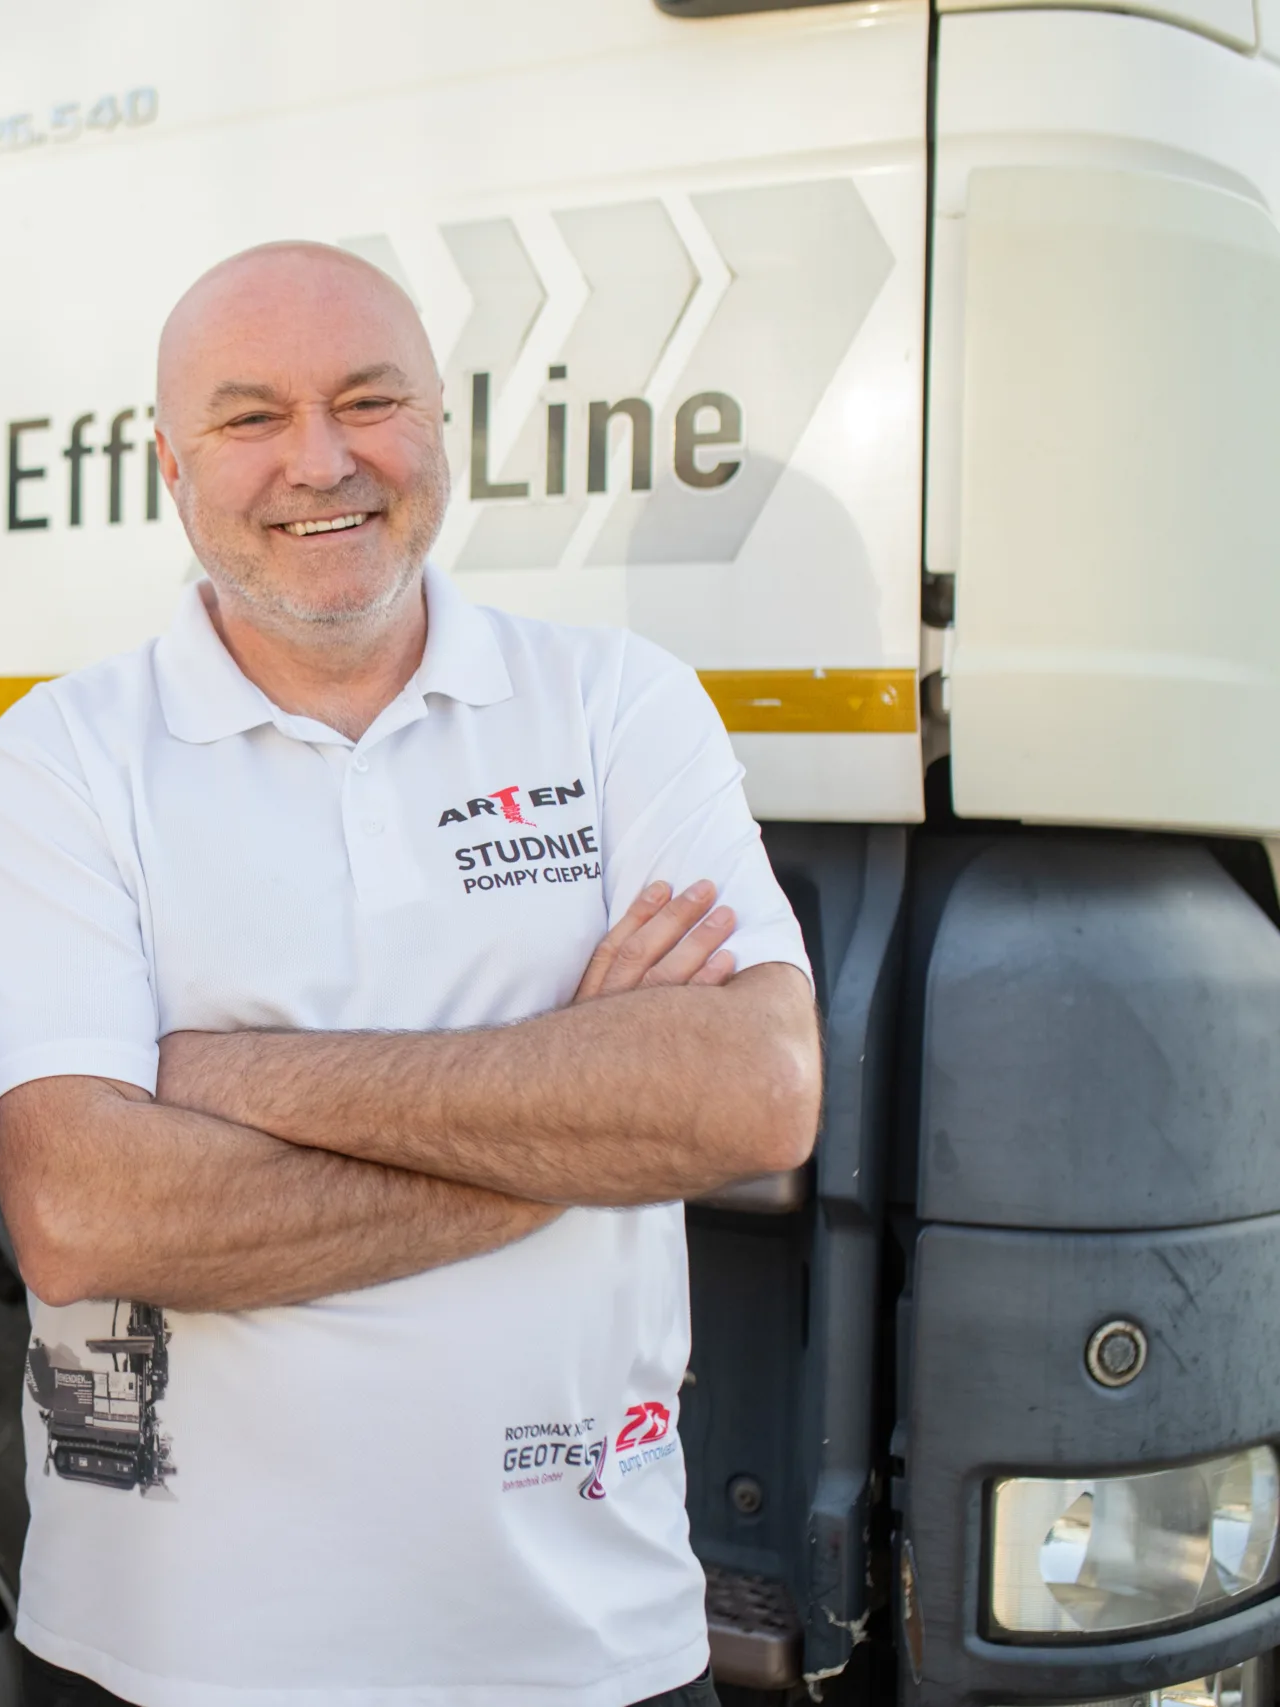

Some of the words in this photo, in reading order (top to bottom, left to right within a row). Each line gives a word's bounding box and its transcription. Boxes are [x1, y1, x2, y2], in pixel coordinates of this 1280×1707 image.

[437, 778, 586, 828] ARTEN
[455, 825, 599, 871] STUDNIE
[463, 868, 539, 894] POMPY
[543, 862, 601, 883] CIEPŁA
[505, 1423, 572, 1441] ROTOMAX
